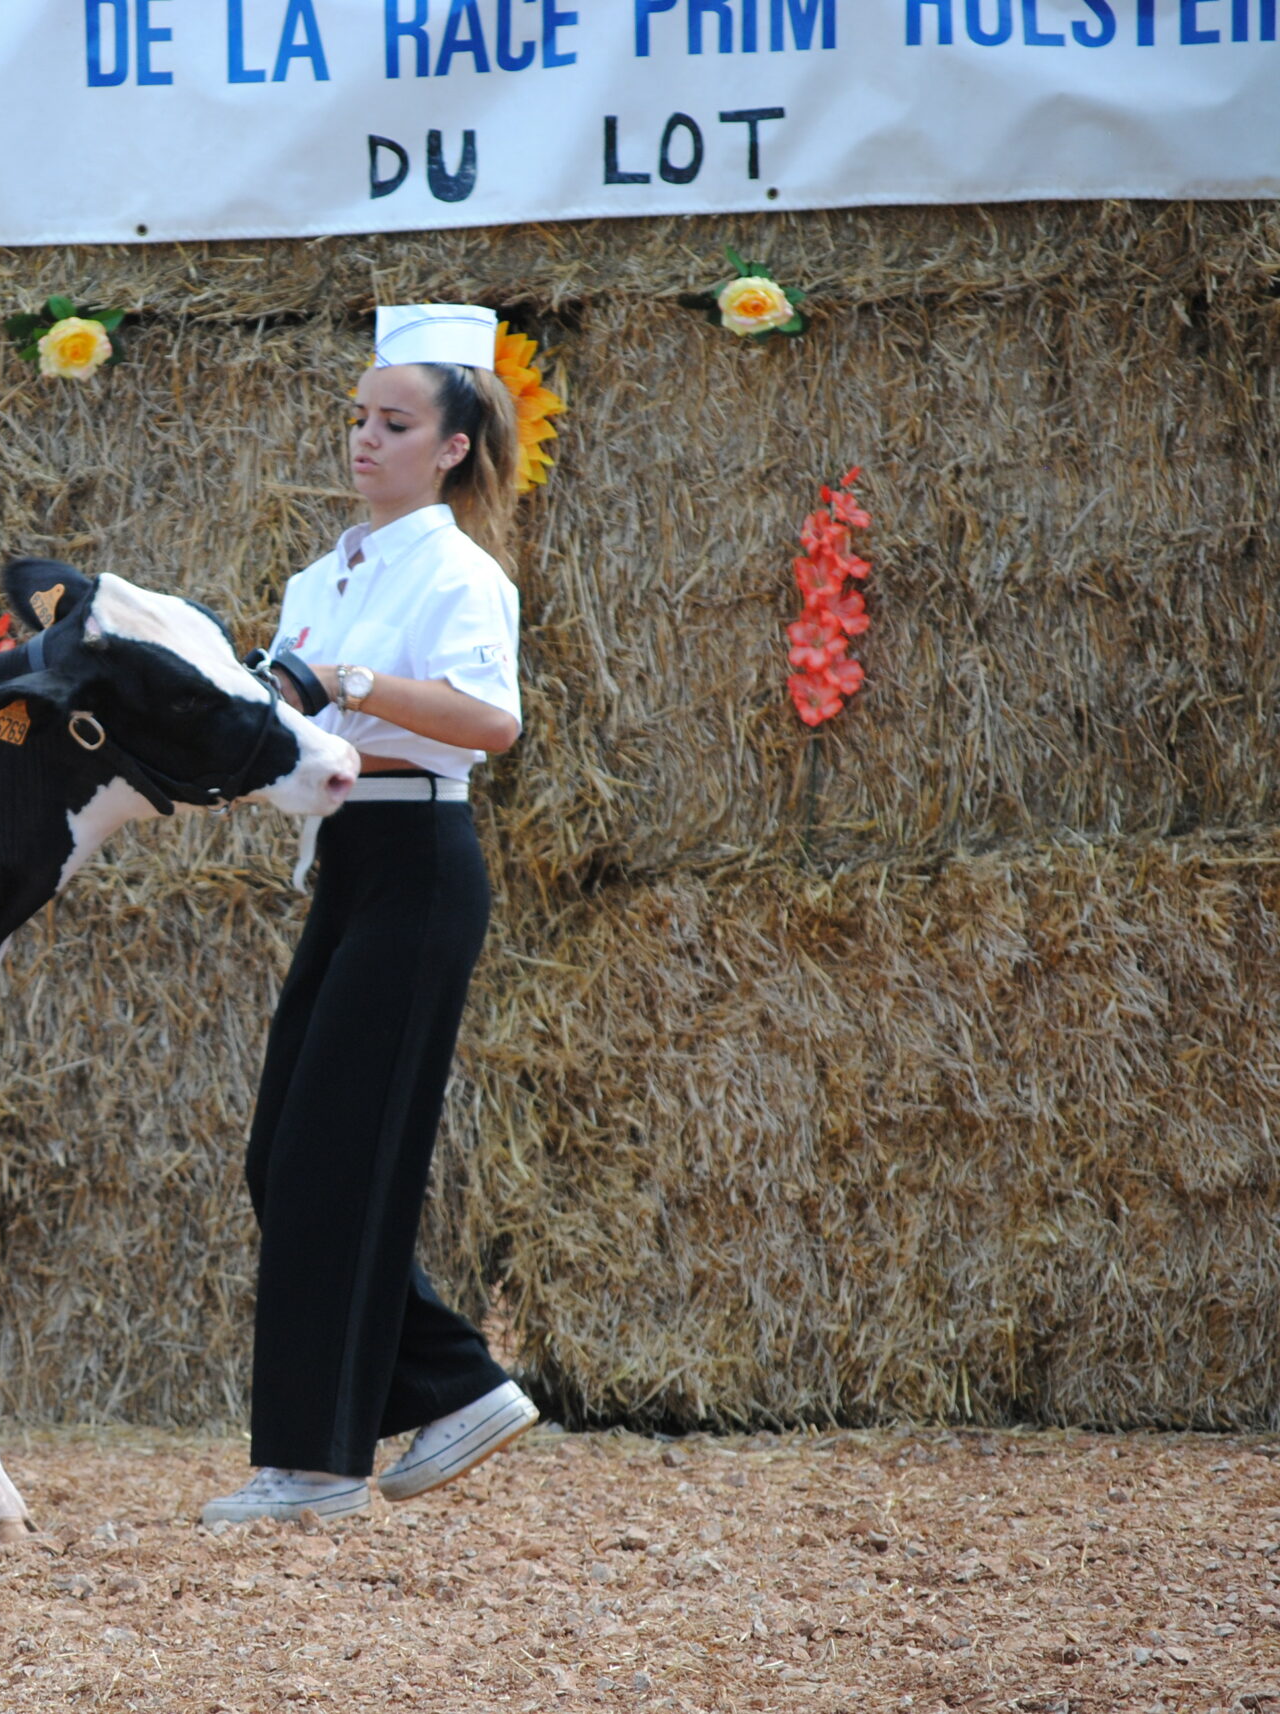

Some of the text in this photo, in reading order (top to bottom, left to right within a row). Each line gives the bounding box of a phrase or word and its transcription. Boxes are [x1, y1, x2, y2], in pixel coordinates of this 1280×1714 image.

[86, 0, 173, 87] DE
[227, 0, 331, 84] LA
[385, 0, 579, 79] RACE
[368, 107, 784, 203] DU LOT
